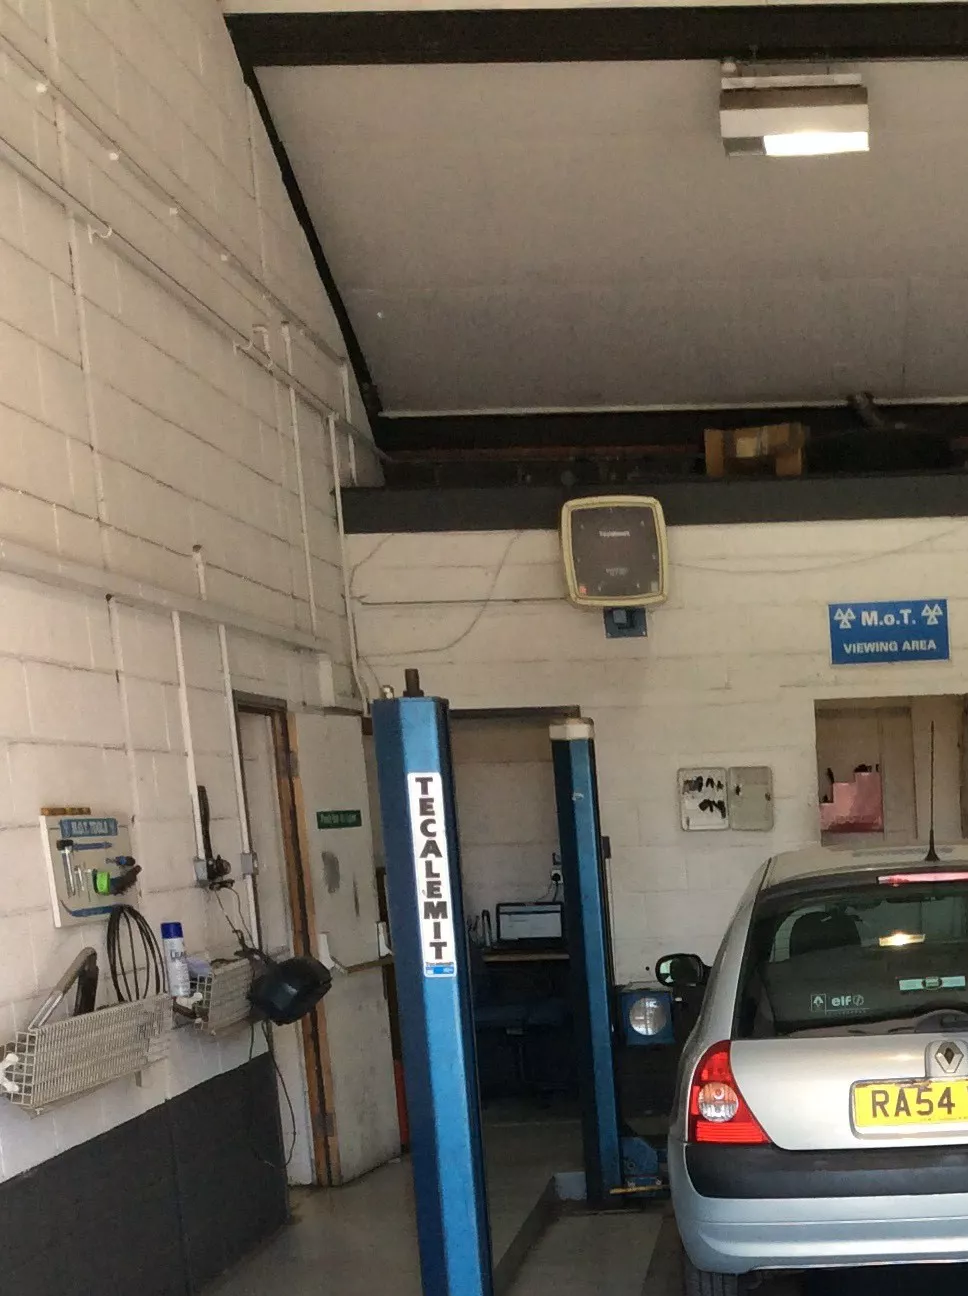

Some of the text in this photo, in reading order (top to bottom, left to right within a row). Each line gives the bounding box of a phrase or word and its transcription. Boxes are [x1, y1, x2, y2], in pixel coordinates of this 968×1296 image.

[843, 639, 937, 654] VIEWING AREA
[415, 777, 448, 960] TECALEMIT
[831, 995, 852, 1007] elf
[871, 1086, 956, 1119] RA54
